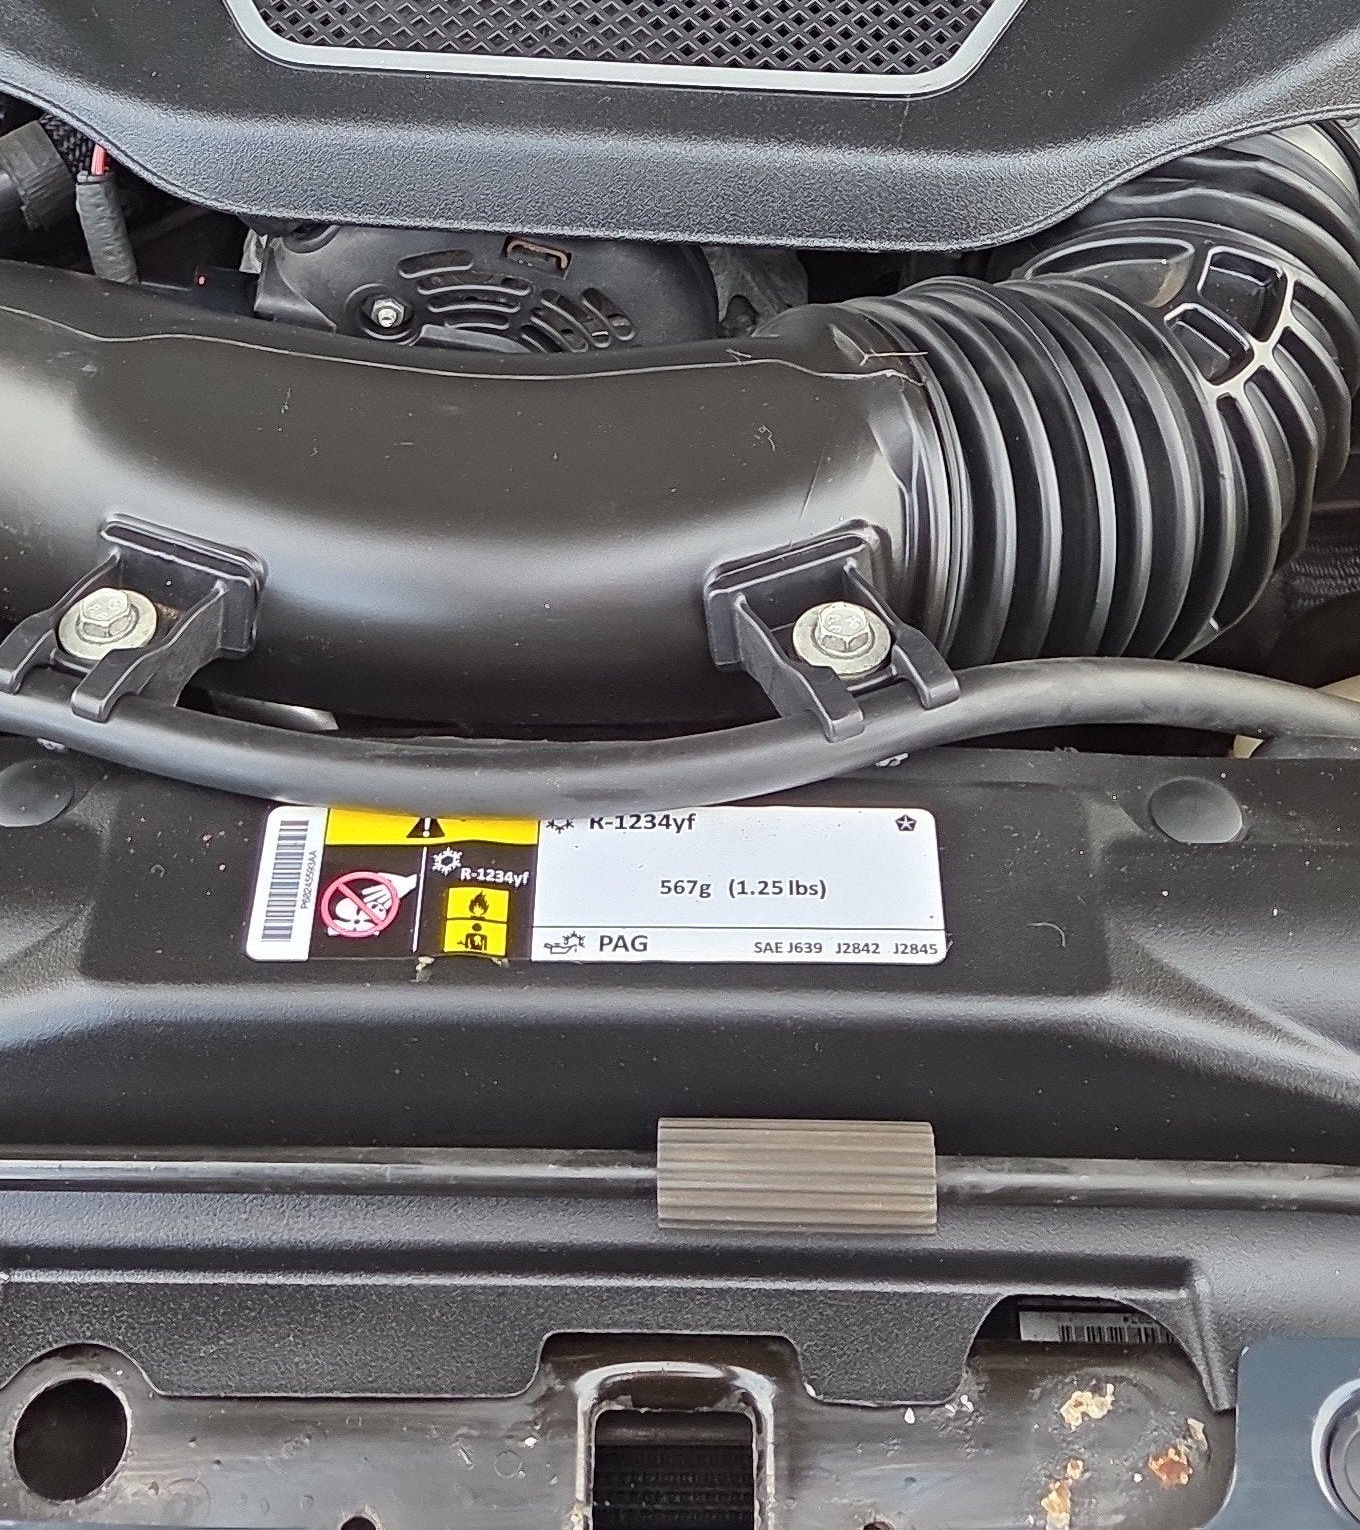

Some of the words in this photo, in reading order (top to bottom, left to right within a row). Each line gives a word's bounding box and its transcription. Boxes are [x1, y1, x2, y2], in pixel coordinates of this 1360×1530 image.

[589, 813, 697, 834] R-1234yf
[459, 867, 530, 889] R-1234yf
[660, 879, 712, 899] 567g
[728, 879, 784, 899] (1.25
[789, 879, 827, 900] lbs)
[599, 935, 649, 952] PAG
[754, 941, 783, 954] SAE
[787, 942, 823, 954] J639
[835, 942, 881, 955] J2842
[892, 942, 938, 955] J2845
